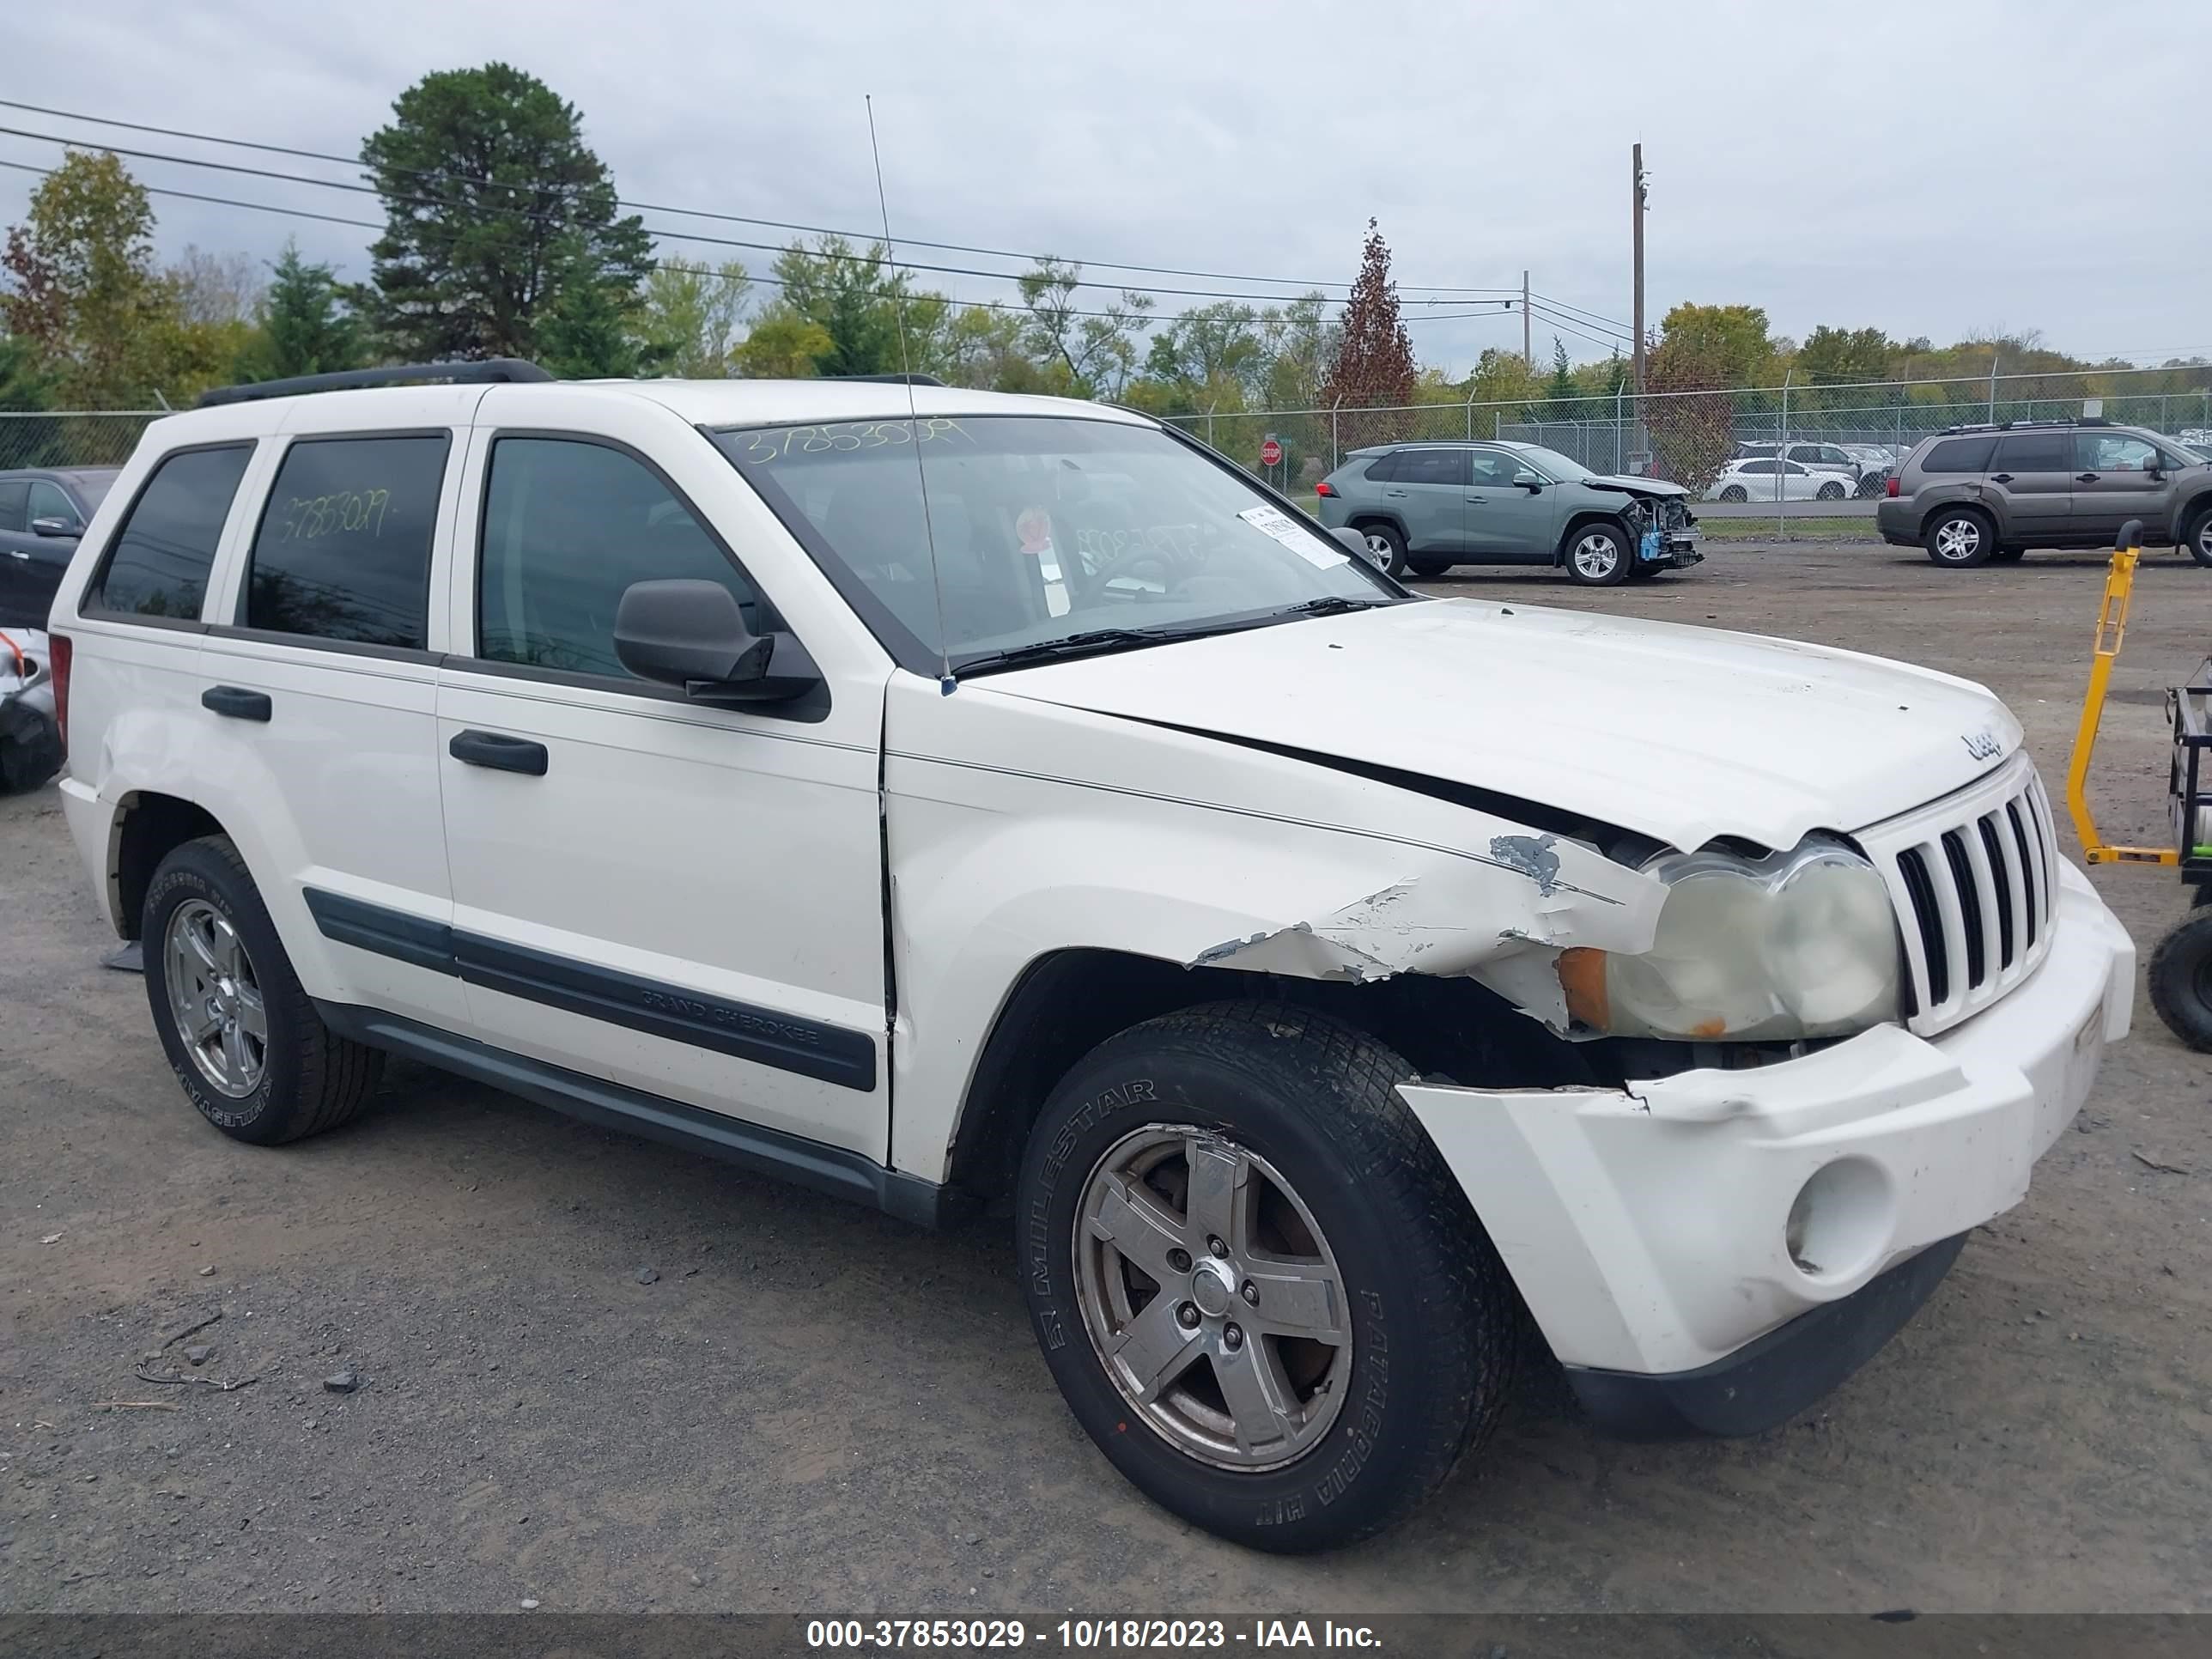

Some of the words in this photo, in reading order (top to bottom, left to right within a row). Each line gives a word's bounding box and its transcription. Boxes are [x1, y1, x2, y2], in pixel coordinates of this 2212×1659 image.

[1263, 448, 1279, 458] STOP
[1961, 735, 2002, 761] Jeep
[643, 990, 706, 1017] GRAND
[714, 1008, 820, 1045] CHEROKEE
[1030, 1079, 1158, 1297] MILESTAR
[1315, 1290, 1389, 1507] PATAGONIA
